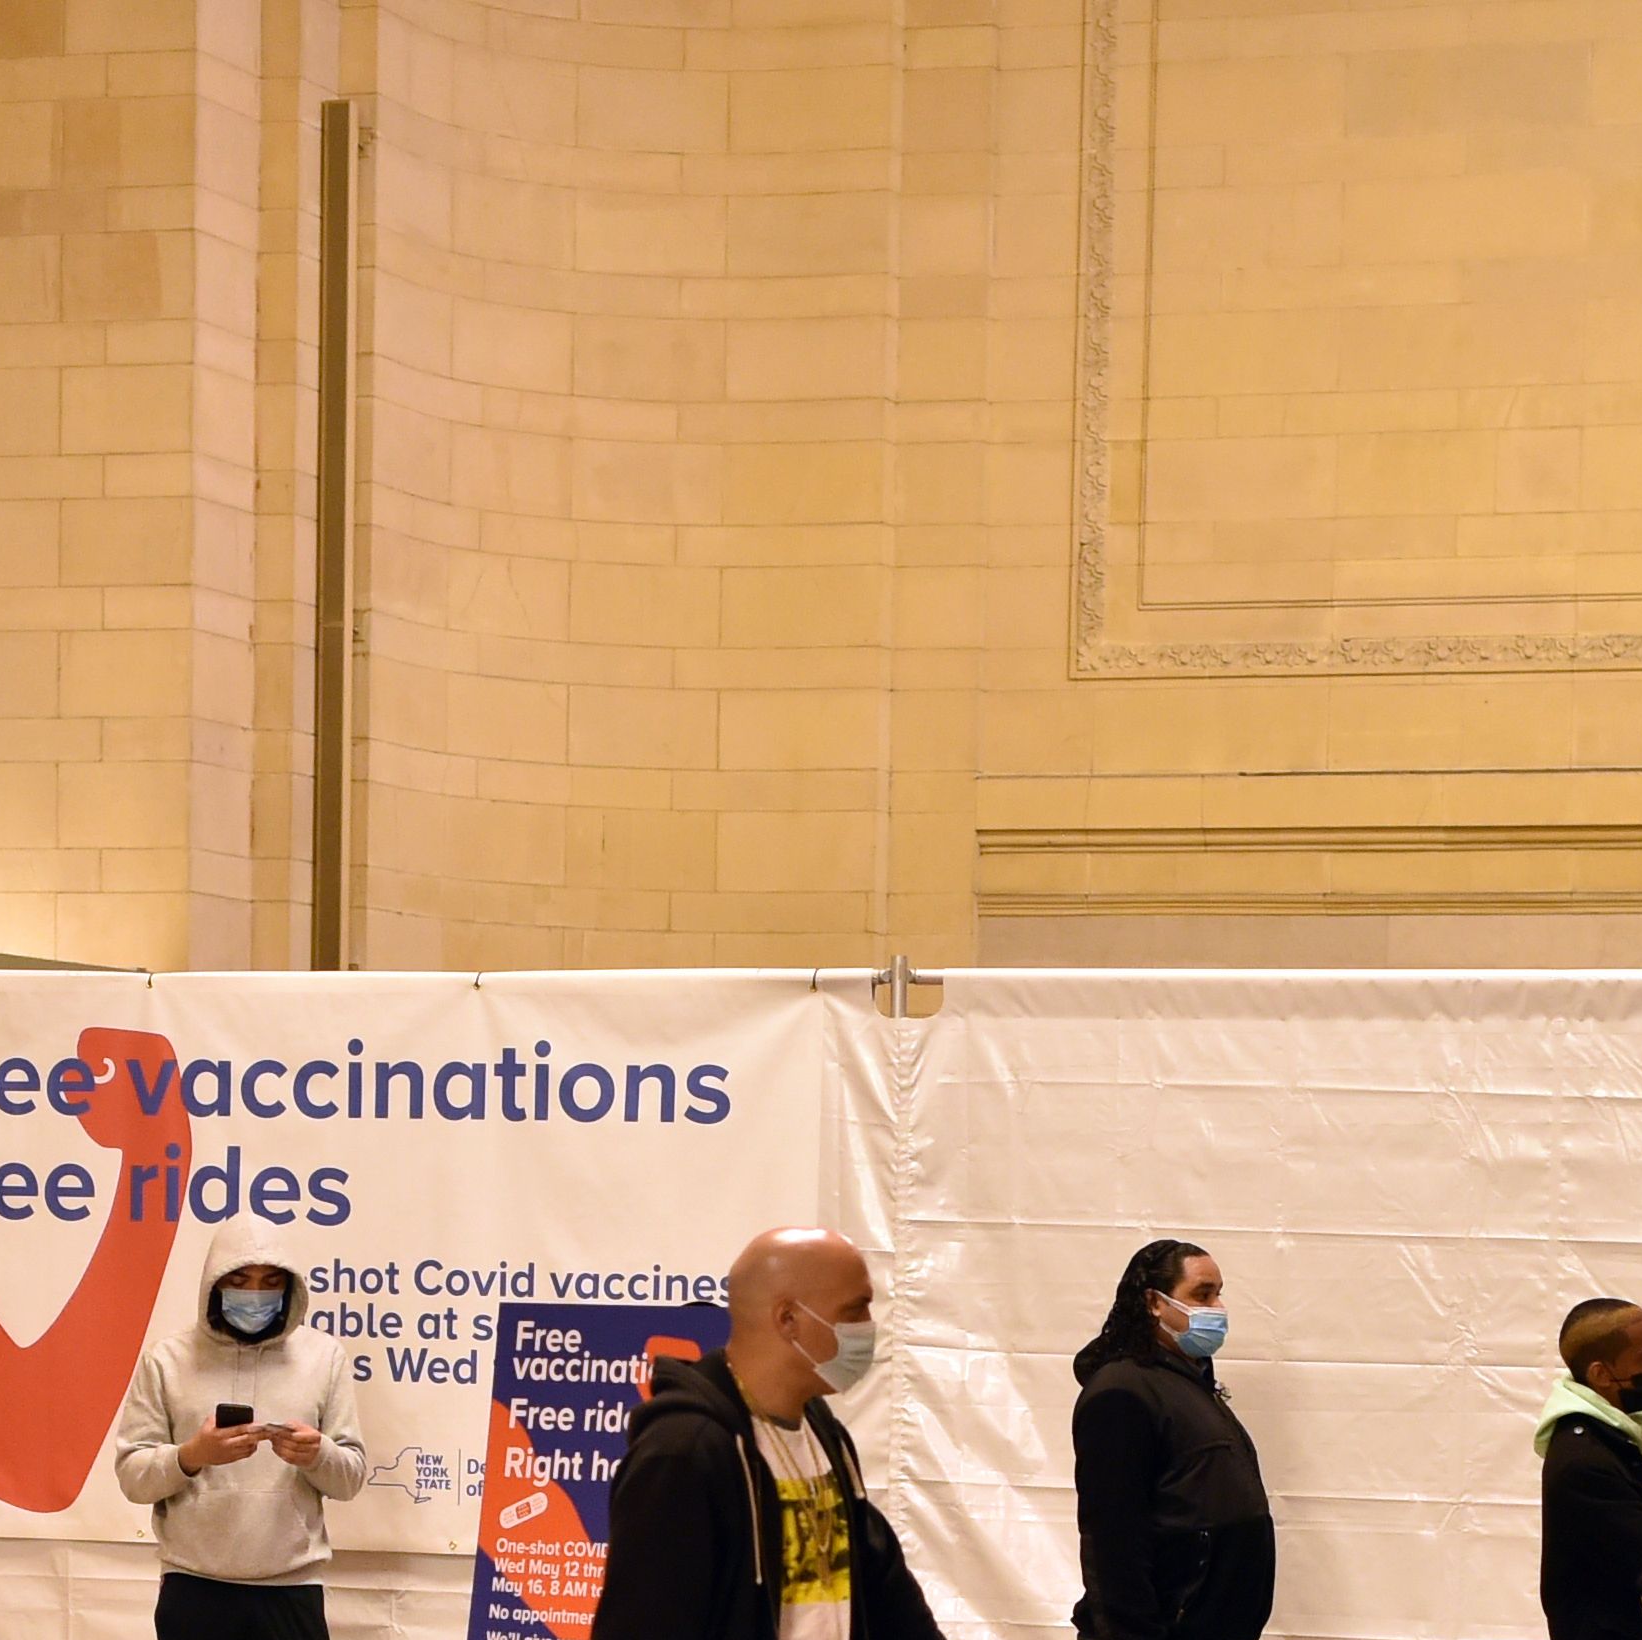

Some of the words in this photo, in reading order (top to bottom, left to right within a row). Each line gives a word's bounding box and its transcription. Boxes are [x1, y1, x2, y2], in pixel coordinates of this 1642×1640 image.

[126, 1038, 731, 1125] vaccinations
[130, 1142, 351, 1226] rides
[304, 1258, 400, 1295] shot
[414, 1259, 535, 1298] Covid
[309, 1302, 403, 1339] able
[417, 1307, 458, 1340] at
[515, 1320, 582, 1353] Free
[387, 1347, 478, 1385] Wed
[509, 1398, 575, 1432] Free
[415, 1467, 449, 1478] YORK
[416, 1455, 443, 1466] NEW
[504, 1446, 582, 1487] Right
[415, 1479, 451, 1490] STATE
[496, 1537, 560, 1556] One-shot
[494, 1557, 525, 1574] Wed
[529, 1560, 560, 1579] May
[565, 1561, 579, 1577] 12
[583, 1563, 605, 1578] thr
[492, 1576, 523, 1596] May
[527, 1578, 546, 1597] 16,
[550, 1580, 560, 1596] 8
[563, 1582, 587, 1597] AM
[489, 1604, 510, 1619] No
